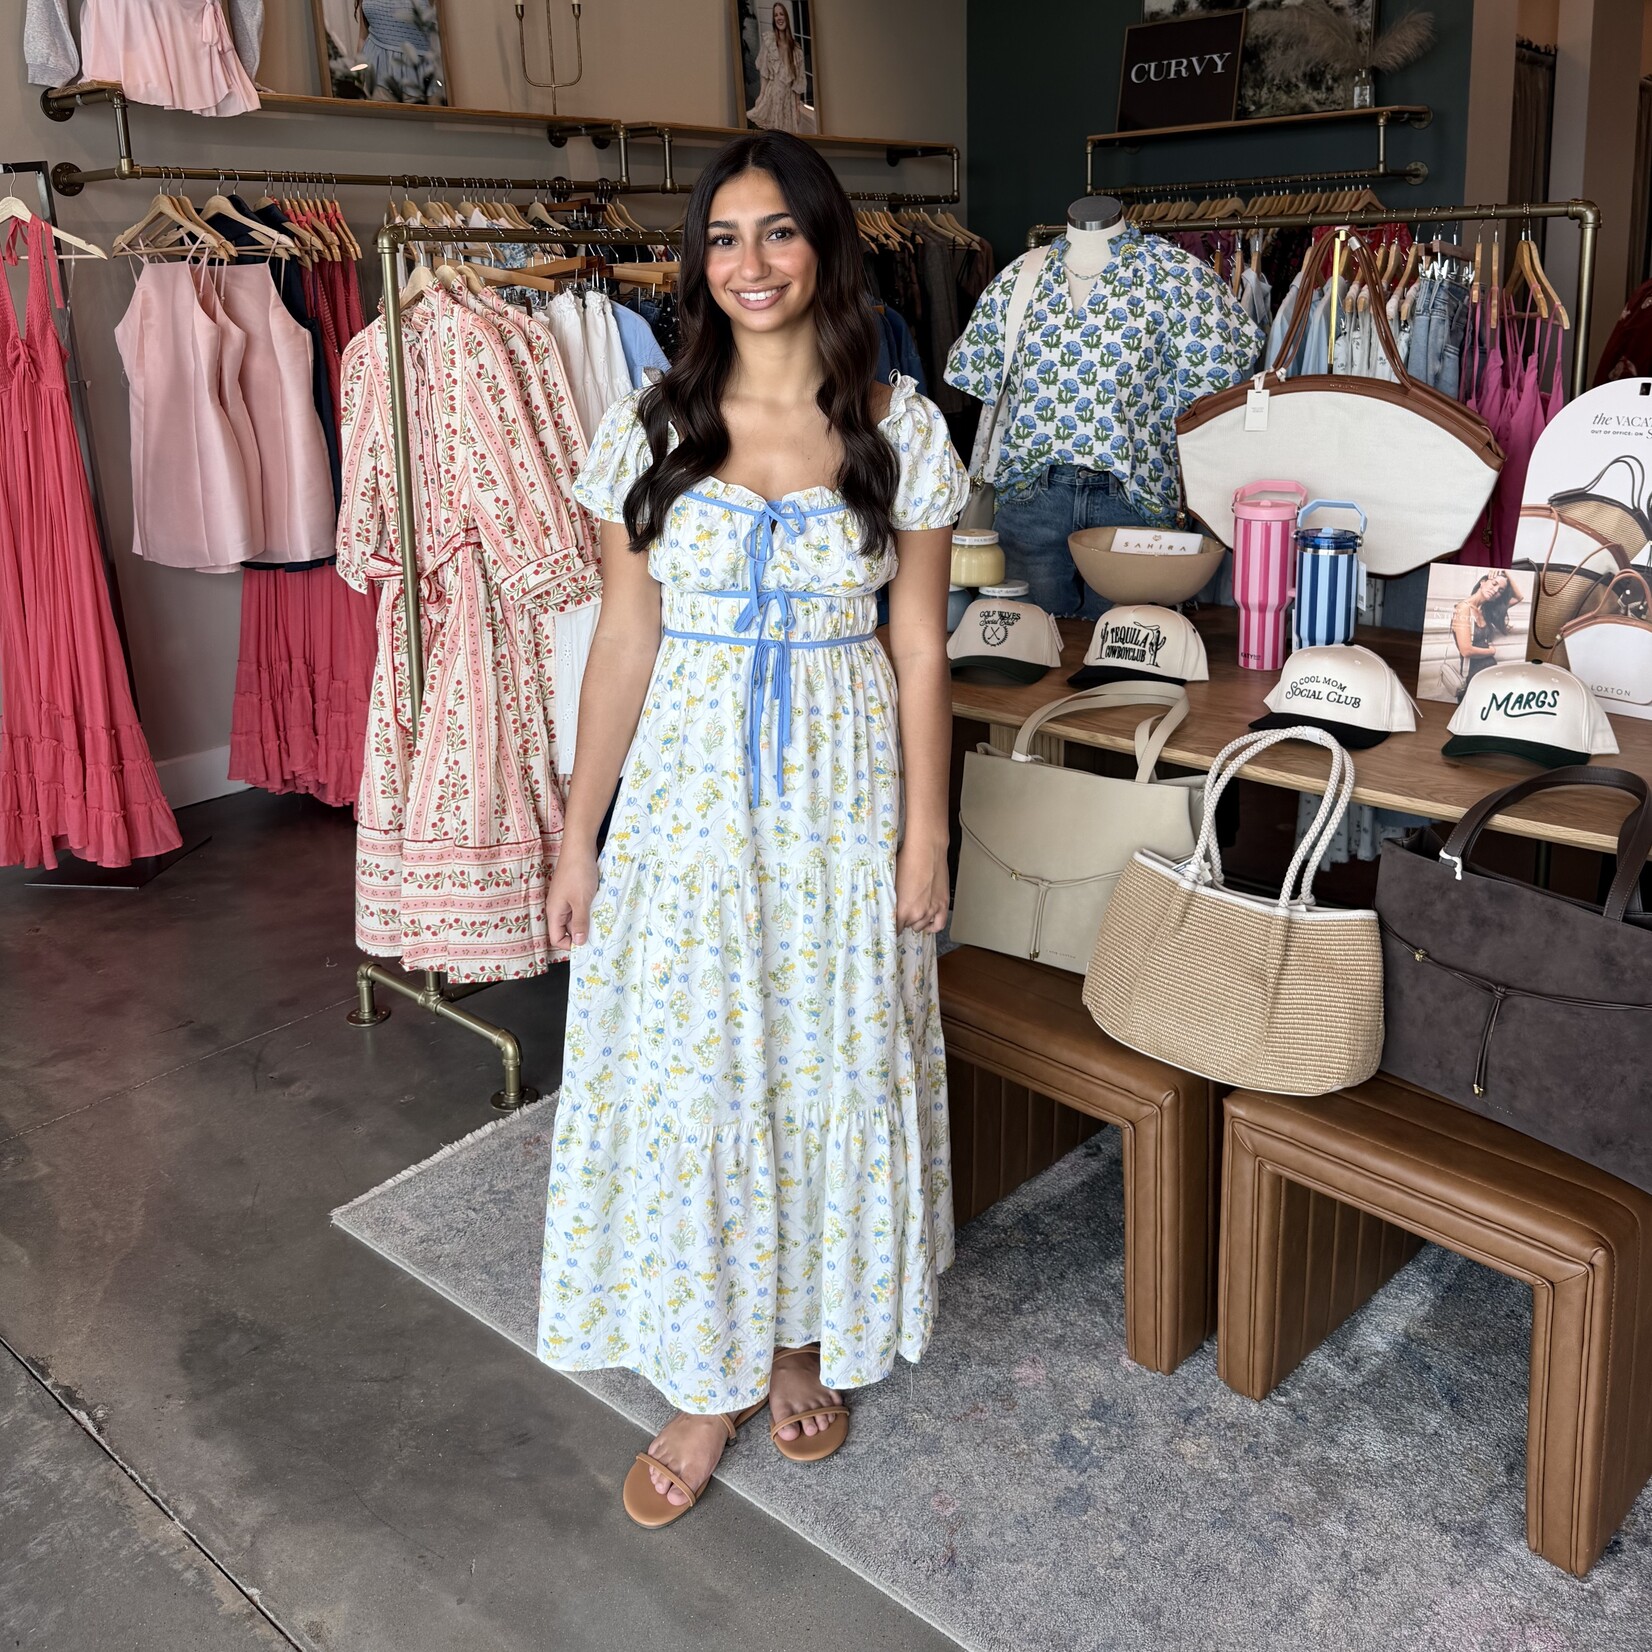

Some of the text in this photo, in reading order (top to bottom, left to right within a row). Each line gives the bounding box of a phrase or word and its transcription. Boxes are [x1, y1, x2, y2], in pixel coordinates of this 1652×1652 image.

[1130, 52, 1232, 84] CURVY
[1592, 413, 1612, 426] the
[1122, 541, 1187, 552] SAHIRA
[979, 610, 1021, 620] GOLF WIVES
[1110, 625, 1150, 648] TEQUILA
[1299, 675, 1347, 692] COOL MOM
[1590, 684, 1632, 697] LOXTON
[1480, 689, 1560, 721] MARGS
